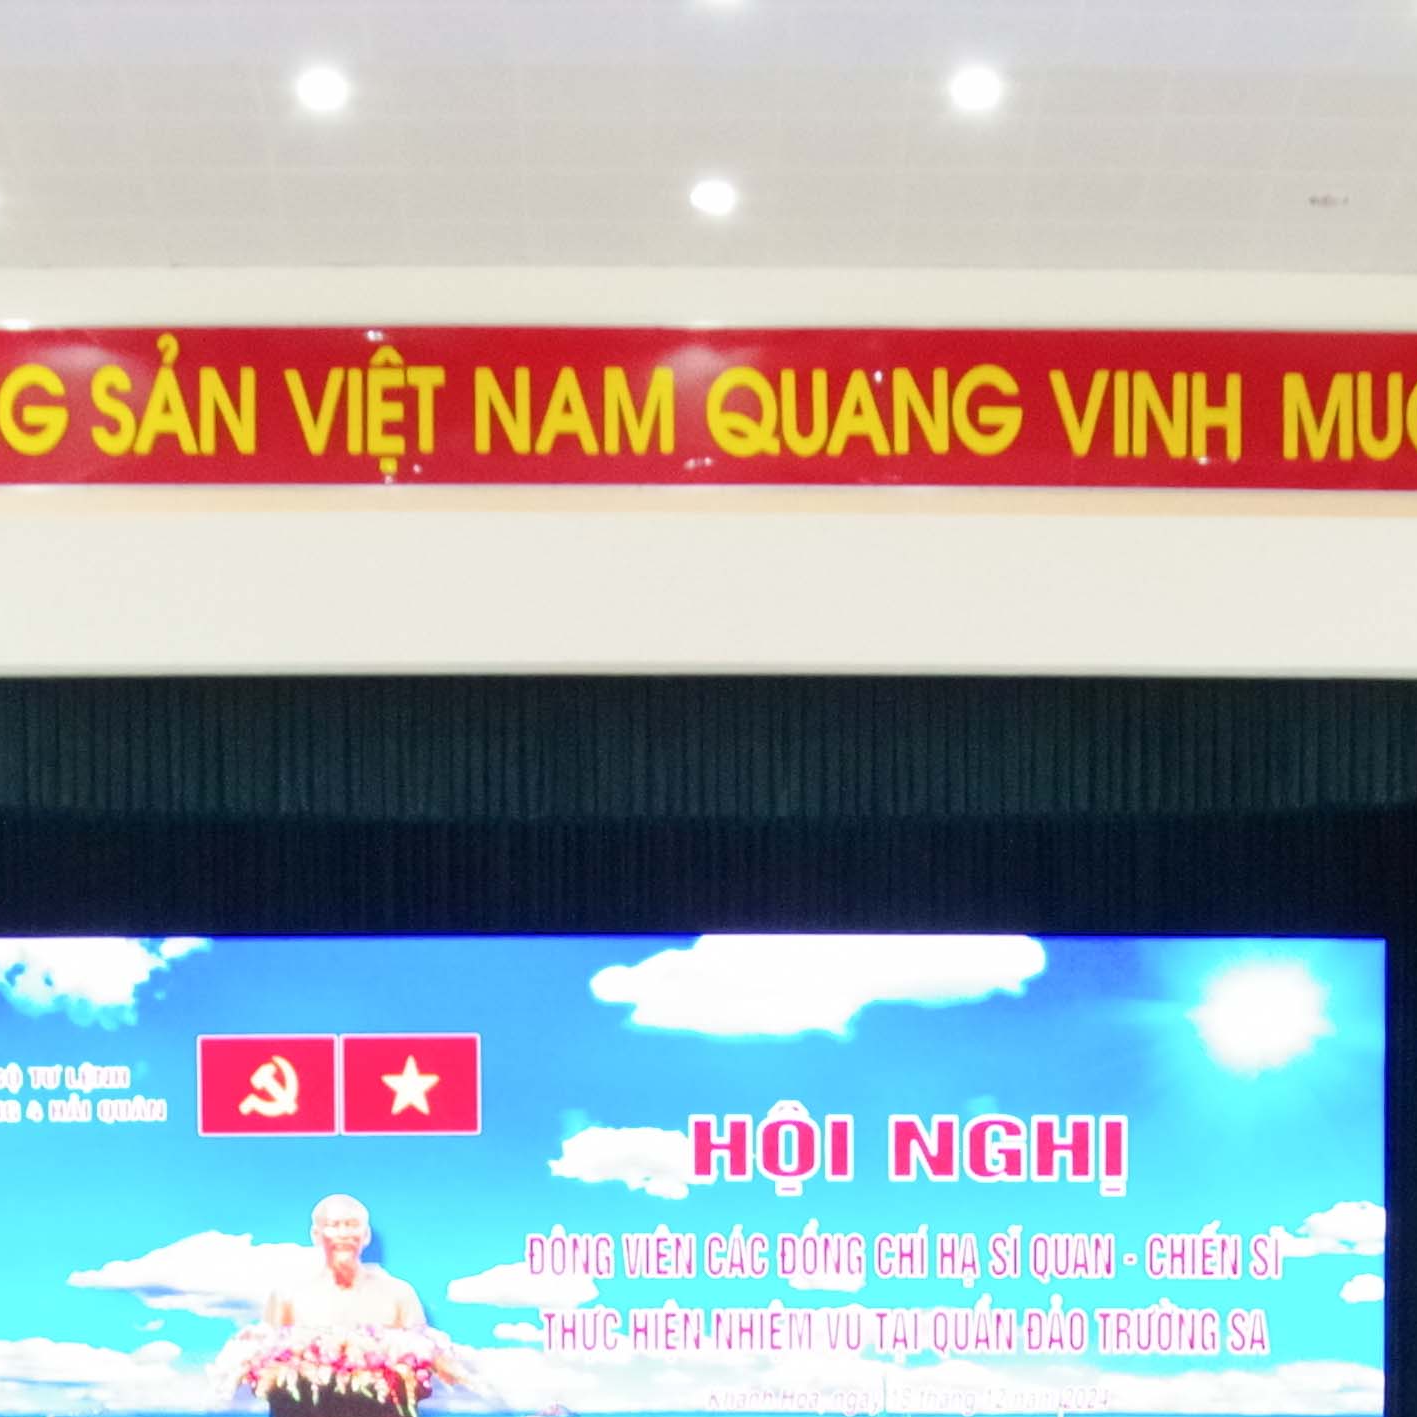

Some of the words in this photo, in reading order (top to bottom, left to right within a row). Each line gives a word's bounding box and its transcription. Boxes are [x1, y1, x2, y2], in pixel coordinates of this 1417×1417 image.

[89, 334, 256, 456] SẢN
[283, 345, 445, 474] VIỆT
[474, 364, 675, 456] NAM
[706, 364, 1024, 461] QUANG
[1049, 369, 1243, 462] VINH
[691, 1101, 854, 1194] HỘI
[890, 1116, 1125, 1194] NGHỊ
[706, 1225, 767, 1277] CÁC
[877, 1225, 928, 1277] CHÍ
[1031, 1236, 1113, 1281] QUAN
[1230, 1311, 1266, 1351] SA
